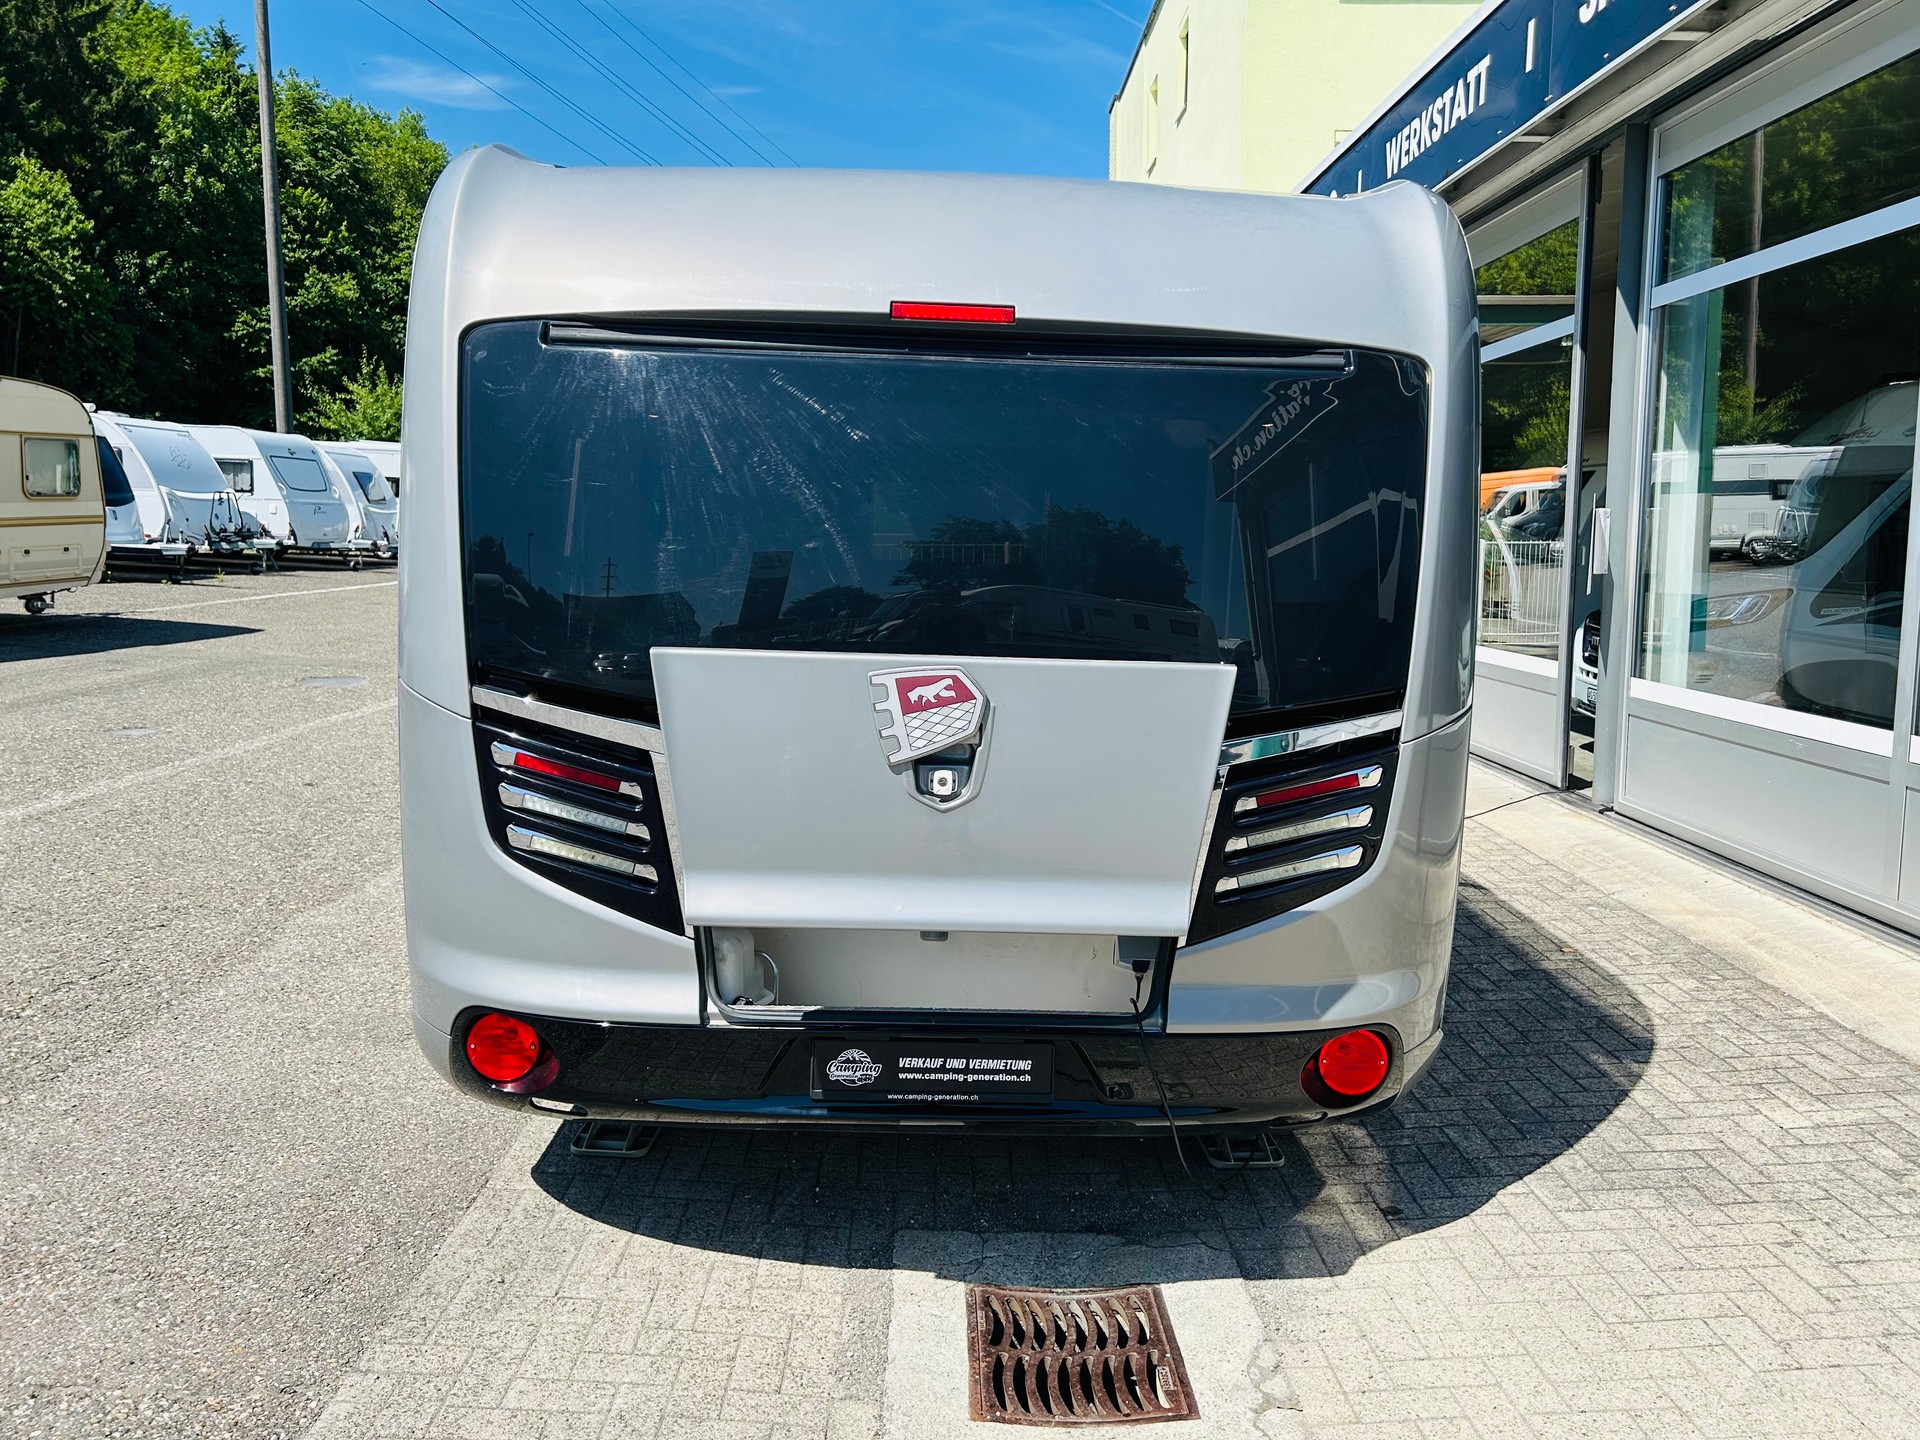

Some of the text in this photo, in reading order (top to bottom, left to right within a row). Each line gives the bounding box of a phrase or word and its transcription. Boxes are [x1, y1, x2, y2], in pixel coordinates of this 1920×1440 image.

[1385, 54, 1491, 179] WERKSTATT
[828, 1061, 882, 1076] Camping
[898, 1057, 1032, 1071] VERKAUF UND VERMIETUNG
[898, 1071, 1032, 1082] www.camping-generation.ch
[887, 1093, 979, 1101] www.camping-generation.ch
